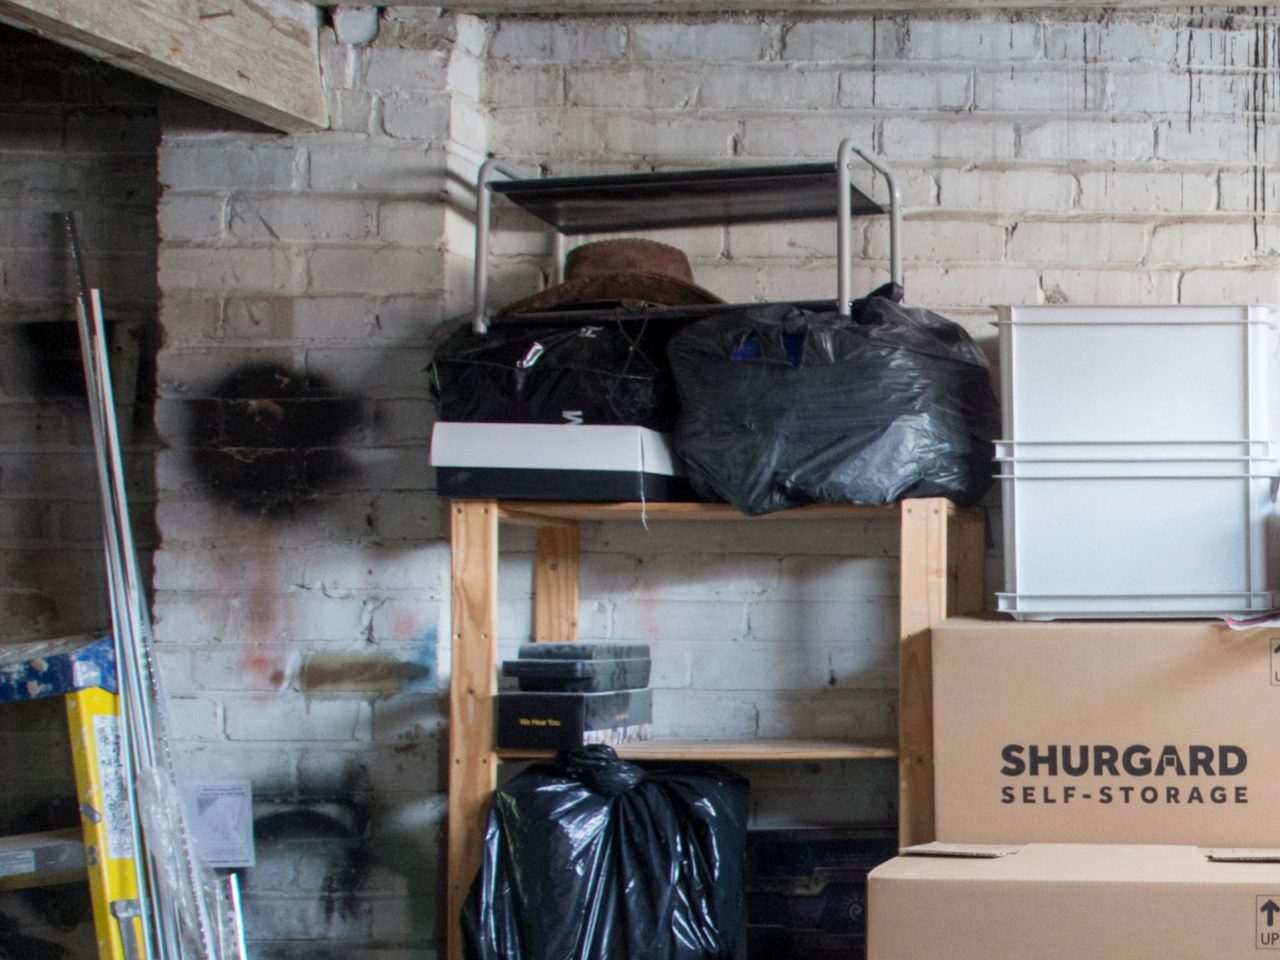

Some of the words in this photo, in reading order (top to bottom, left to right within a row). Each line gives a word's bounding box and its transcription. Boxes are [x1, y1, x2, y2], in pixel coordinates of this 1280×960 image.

[1000, 744, 1248, 777] SHURGARD
[1001, 785, 1248, 804] SELF-STORAGE
[1261, 932, 1280, 945] UP
